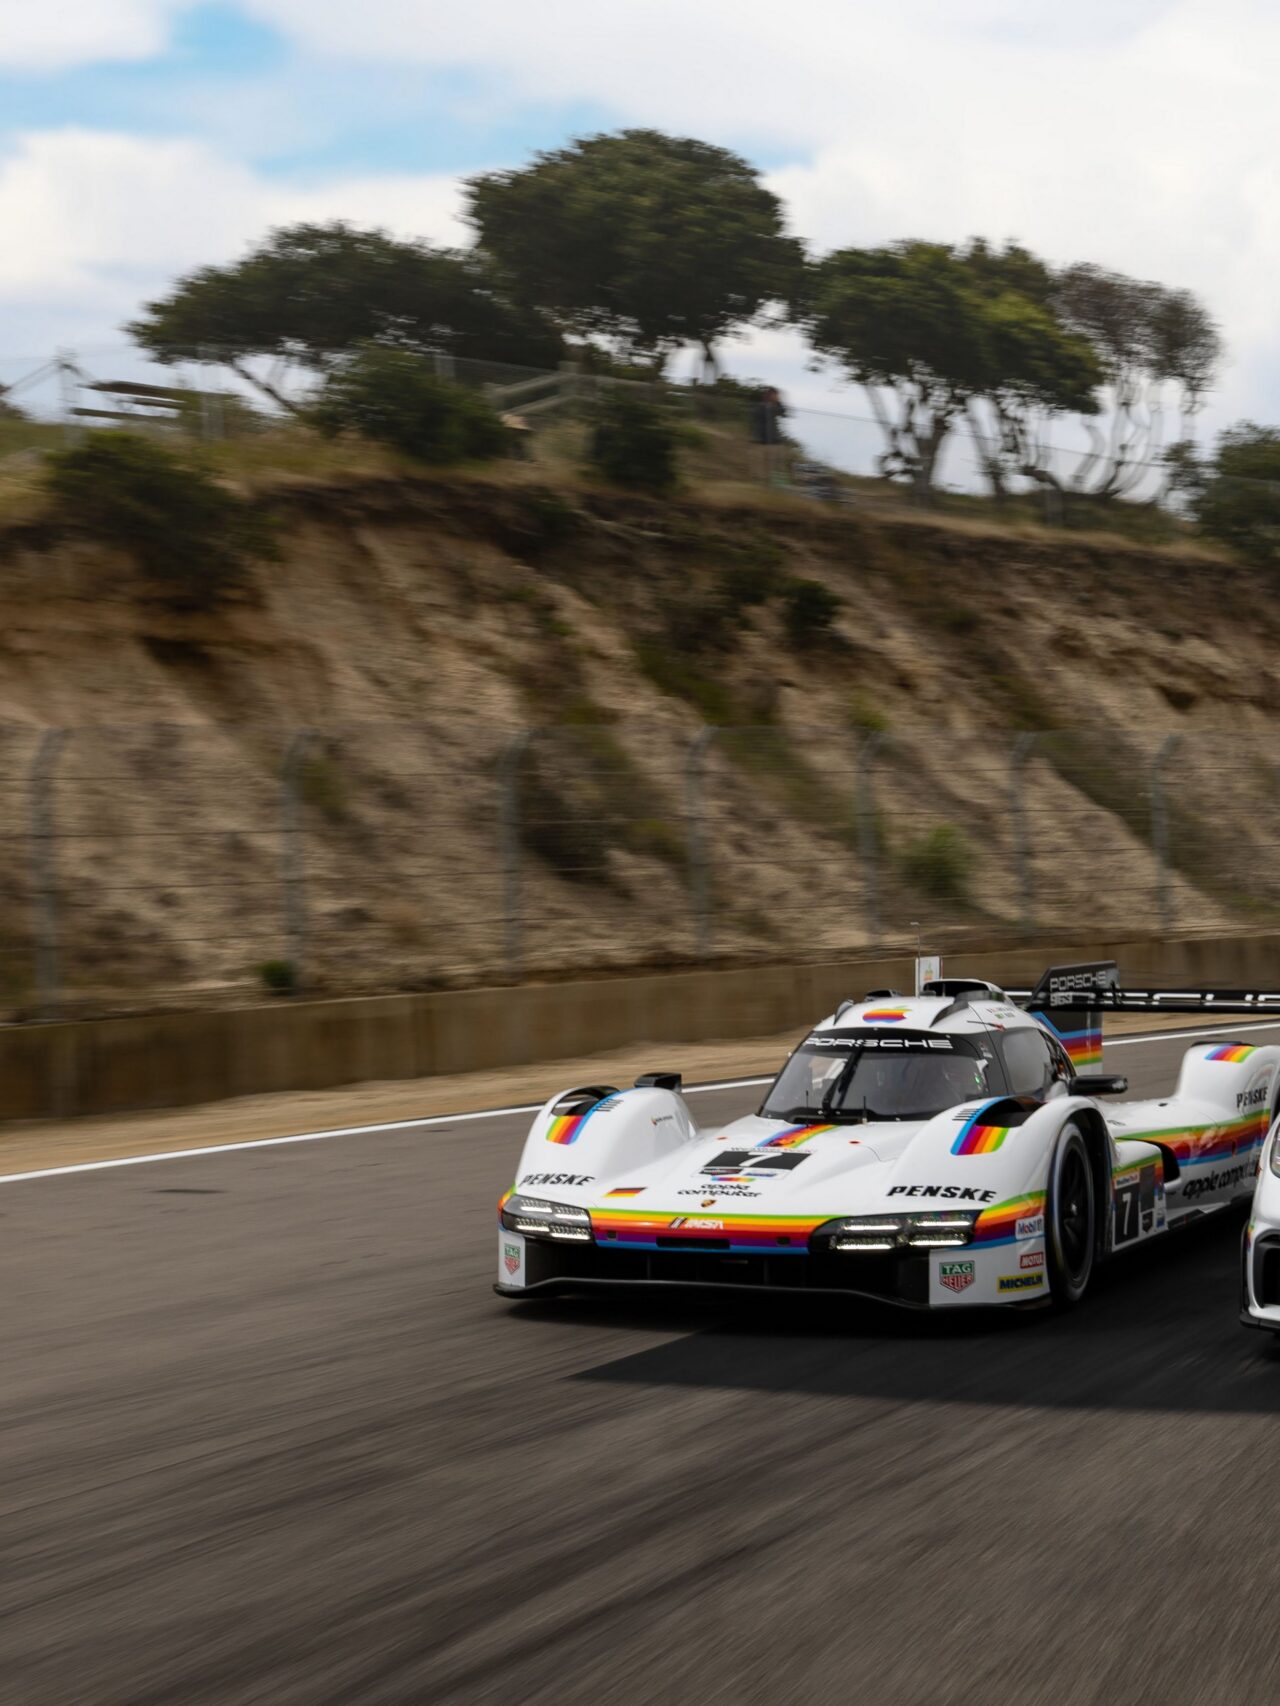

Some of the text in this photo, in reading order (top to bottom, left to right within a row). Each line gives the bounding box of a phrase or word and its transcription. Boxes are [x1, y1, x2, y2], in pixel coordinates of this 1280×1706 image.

[1050, 971, 1107, 992] PORSCHE
[803, 1037, 954, 1050] PORSCHE
[1236, 1086, 1269, 1108] PENSKE
[738, 1151, 784, 1167] 7
[519, 1173, 595, 1188] PENSKE
[886, 1185, 997, 1203] PENSKE
[1122, 1191, 1132, 1235] 7
[943, 1262, 972, 1274] TAG
[1021, 1253, 1044, 1268] MOTUL
[941, 1274, 973, 1291] HEUER
[999, 1274, 1044, 1290] MICHELIN
